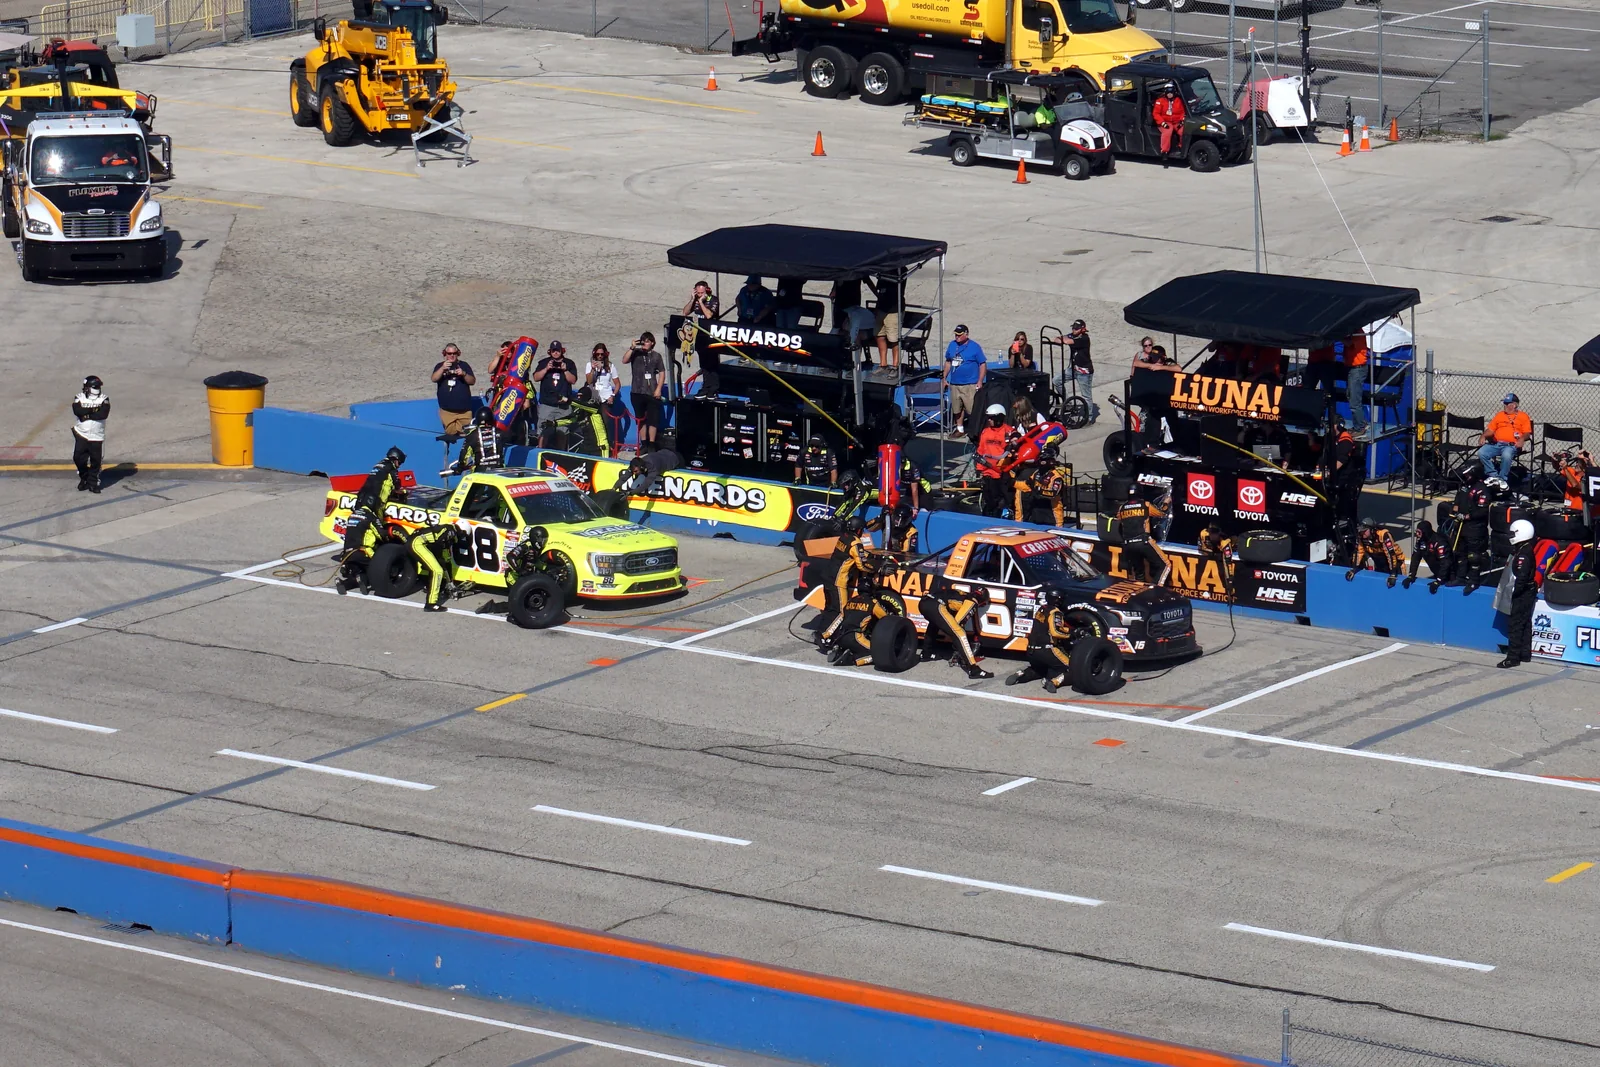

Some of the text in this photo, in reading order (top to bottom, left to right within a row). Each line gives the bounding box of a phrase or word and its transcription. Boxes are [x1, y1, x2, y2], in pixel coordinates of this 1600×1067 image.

[911, 2, 950, 13] usedoil.com
[375, 35, 387, 50] JCB
[386, 113, 409, 121] JCB
[708, 324, 803, 349] MENARDS
[517, 346, 533, 377] SUNOCO
[1170, 373, 1283, 415] LiUNA!
[499, 389, 518, 420] SUNOCO
[1169, 401, 1188, 410] YOUR
[1187, 403, 1208, 412] UNIN
[1247, 410, 1279, 421] SLUTION
[1137, 473, 1174, 485] HRE
[507, 482, 551, 495] CRAFTSMAN
[1280, 491, 1318, 504] HRE
[340, 496, 440, 525] MARDS
[1183, 503, 1219, 517] TOYOTA
[1233, 510, 1270, 523] TOYOTA
[1108, 546, 1235, 595] LNA!
[883, 569, 934, 597] NA!
[1262, 571, 1299, 584] TOYOTA
[1256, 586, 1298, 601] HRE
[1067, 603, 1098, 612] GOODYEAR
[1163, 609, 1184, 619] TOYOTA
[1533, 631, 1561, 641] PEED
[1134, 641, 1145, 650] 16
